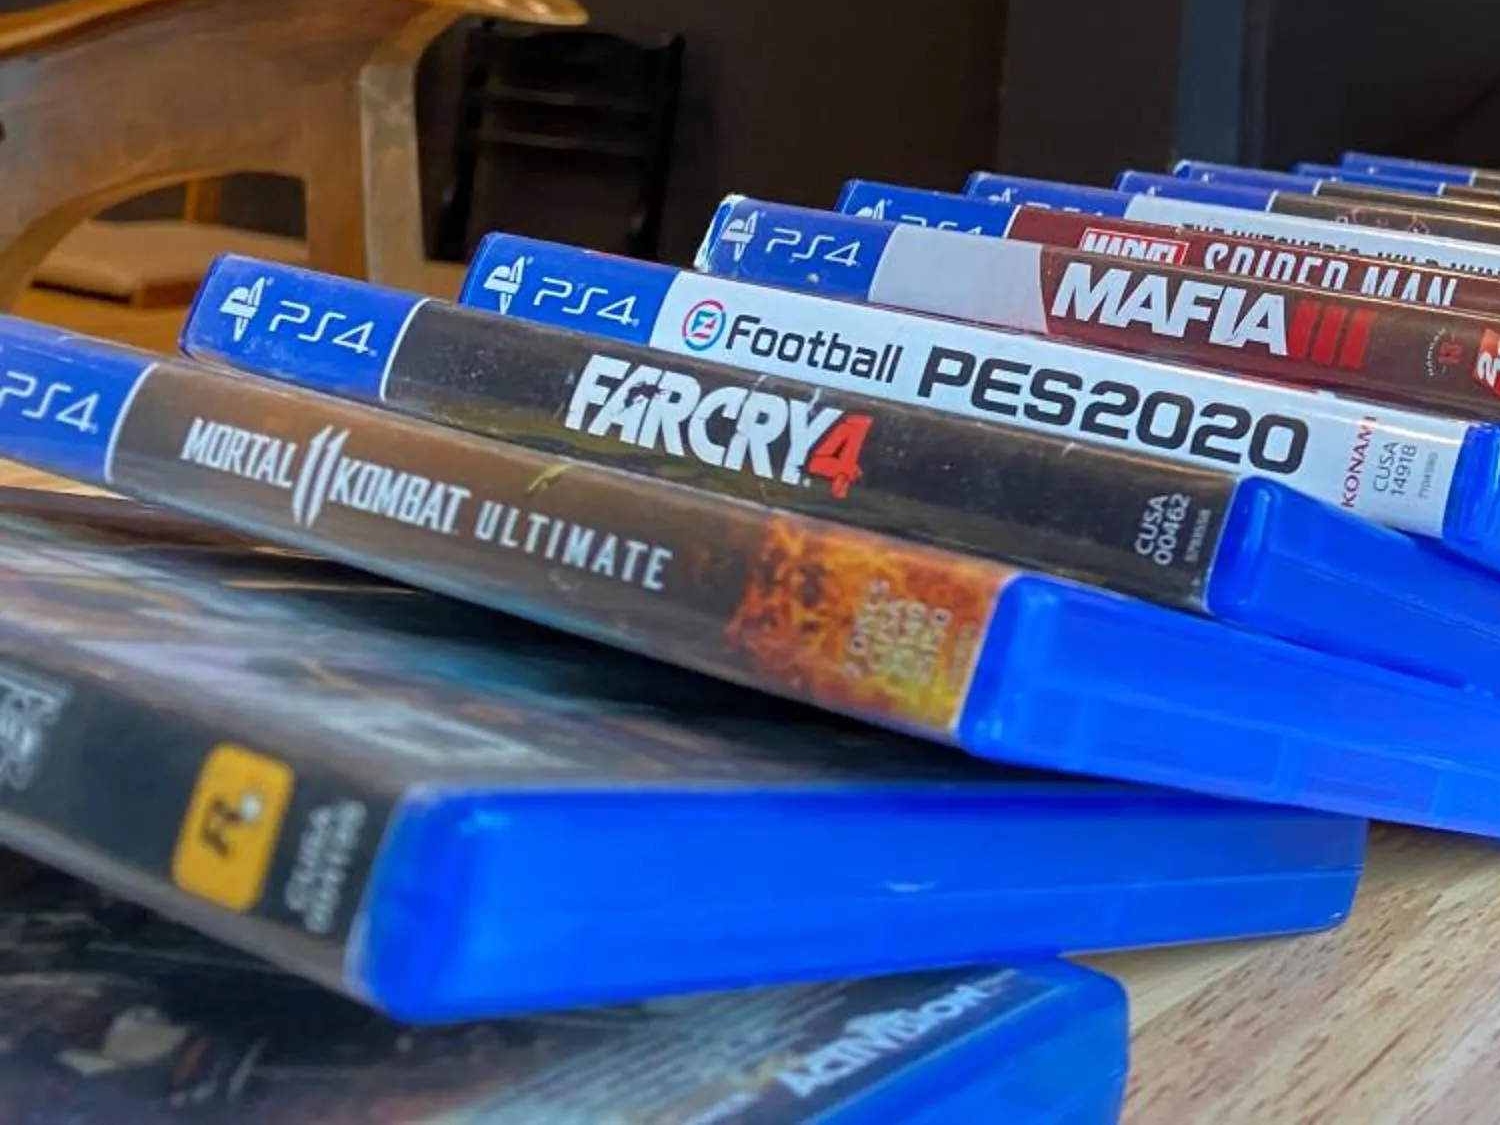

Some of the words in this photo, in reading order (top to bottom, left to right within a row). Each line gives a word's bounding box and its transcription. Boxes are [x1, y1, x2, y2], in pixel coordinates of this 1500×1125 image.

[766, 228, 861, 267] PS4
[269, 300, 374, 354] PS4
[533, 278, 637, 325] PS4
[1051, 262, 1288, 356] MAFIA
[0, 370, 98, 432] PS4
[1341, 416, 1377, 507] KONAMI
[1373, 442, 1399, 492] CUSA
[181, 418, 297, 489] MORTAL
[329, 459, 471, 534] KOMBAT
[474, 500, 673, 592] ULTIMATE
[1134, 495, 1168, 555] CUSA
[1153, 493, 1191, 565] 00462
